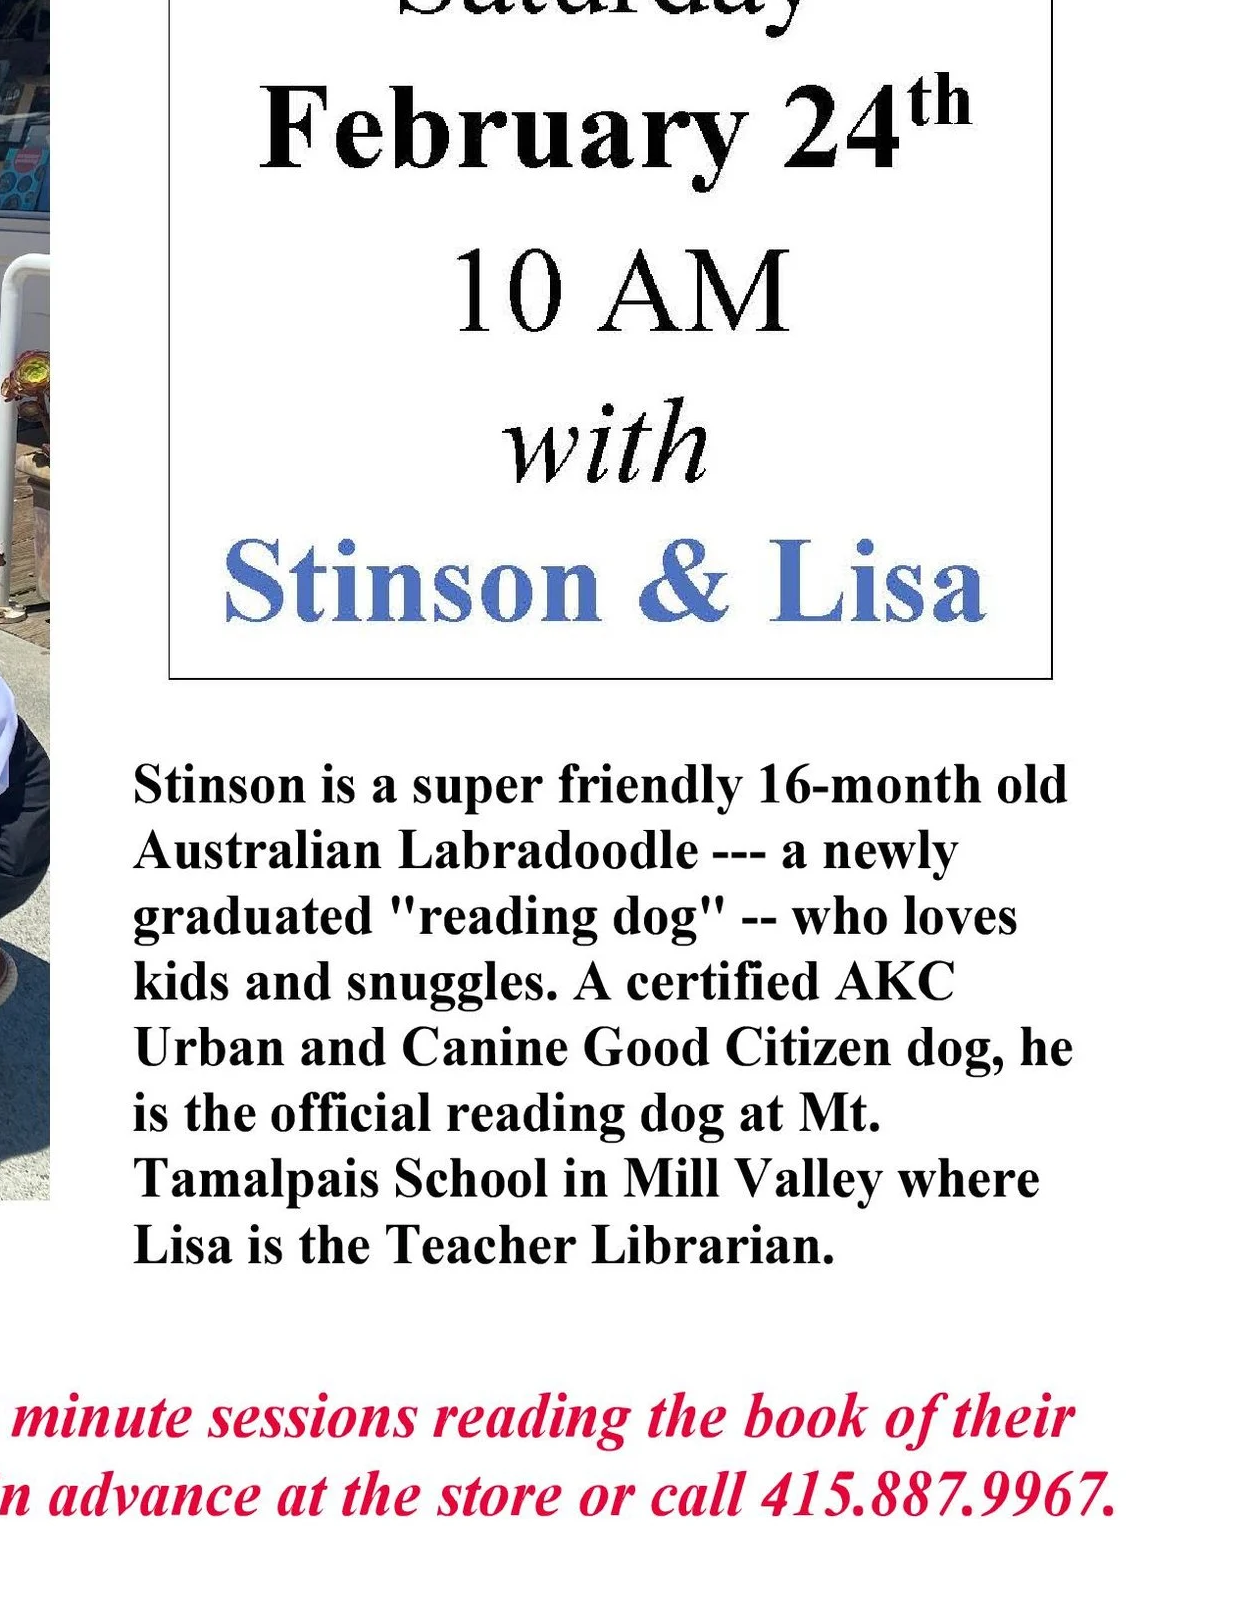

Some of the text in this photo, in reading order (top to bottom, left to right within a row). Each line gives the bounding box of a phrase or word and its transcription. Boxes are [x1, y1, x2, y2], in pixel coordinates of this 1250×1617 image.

[260, 72, 973, 193] February 24th
[457, 248, 789, 332] 10 AM
[502, 396, 706, 483] with
[226, 539, 986, 622] Stinson & Lisa
[135, 763, 1067, 815] Stinson is a super friendly 16-month old
[133, 829, 381, 869] Australian
[398, 830, 698, 869] Labradoodle
[783, 841, 807, 868] a
[824, 830, 958, 880] newly
[134, 895, 372, 946] graduated
[392, 895, 597, 946] "reading
[614, 895, 723, 946] dog"
[792, 895, 887, 935] who
[904, 895, 1016, 935] loves
[134, 960, 954, 1012] kids and snuggles. A certified AKC
[134, 1026, 1072, 1077] Urban and Canine Good Citizen dog, he
[134, 1092, 879, 1143] is the official reading dog at Mt.
[134, 1157, 1039, 1209] Tamalpais School in Mill Valley where
[134, 1224, 833, 1264] Lisa is the Teacher Librarian.
[12, 1392, 192, 1438] minute
[208, 1392, 418, 1438] sessions
[433, 1392, 631, 1451] reading
[648, 1392, 726, 1438] the
[744, 1392, 868, 1438] book
[886, 1393, 948, 1451] of
[953, 1392, 1076, 1438] their
[49, 1471, 260, 1516] advance
[278, 1477, 327, 1516] at
[342, 1470, 420, 1516] the
[437, 1477, 561, 1516] store
[580, 1485, 635, 1516] or
[651, 1471, 747, 1516] call
[761, 1470, 1113, 1516] 415.887.9967.
